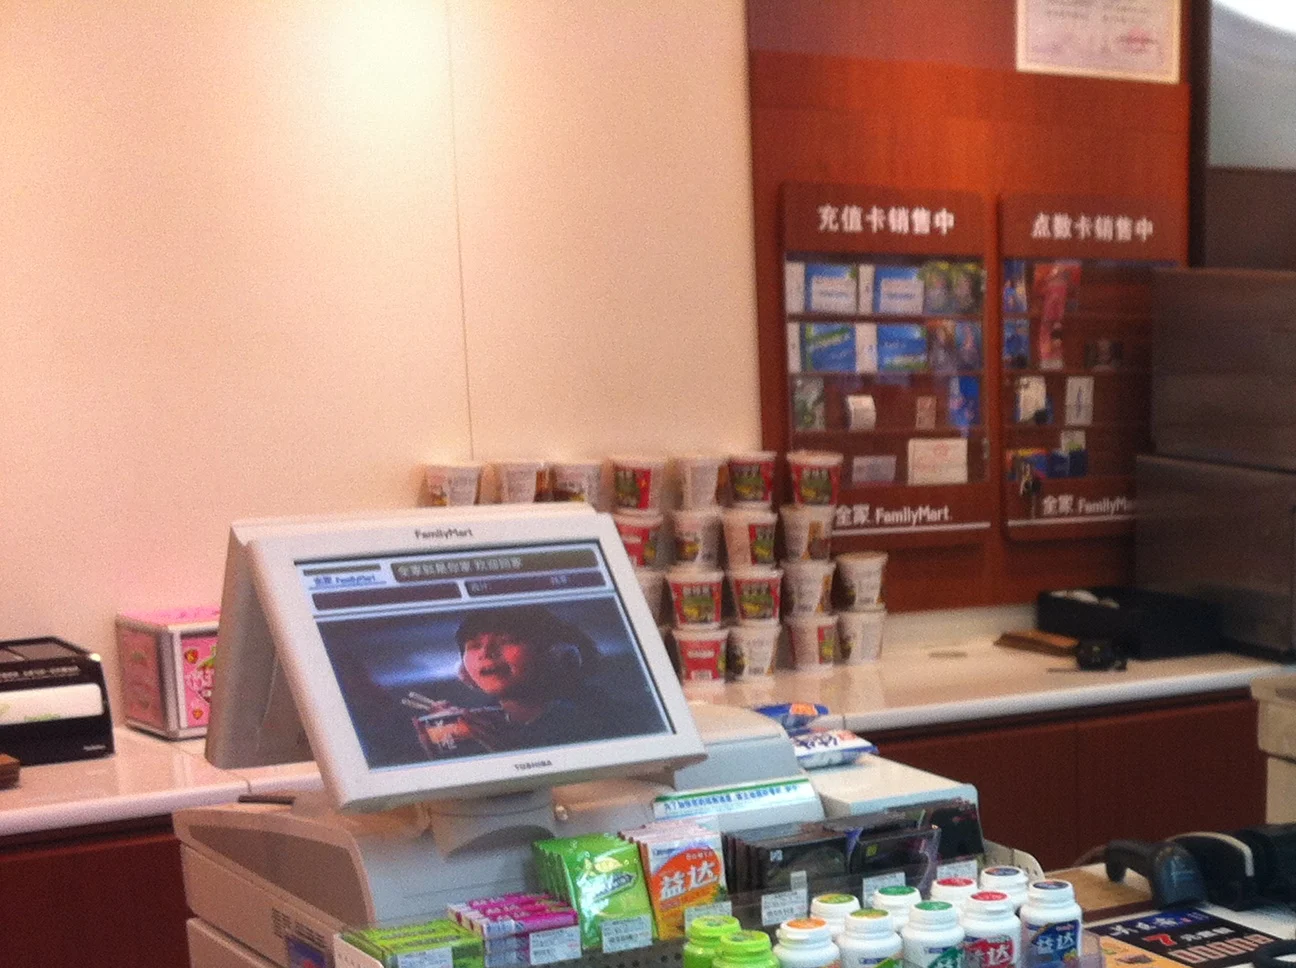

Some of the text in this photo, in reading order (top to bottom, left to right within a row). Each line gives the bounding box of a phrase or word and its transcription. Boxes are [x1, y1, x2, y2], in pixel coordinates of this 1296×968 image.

[817, 204, 955, 235] 充值卡销售中
[1031, 212, 1153, 242] 点数卡销售中
[835, 504, 950, 527] 全家 FamilyMart
[414, 528, 473, 541] FamilyMart
[514, 760, 553, 771] TOSHIBA
[661, 860, 717, 900] 益达
[1037, 933, 1076, 955] 益达
